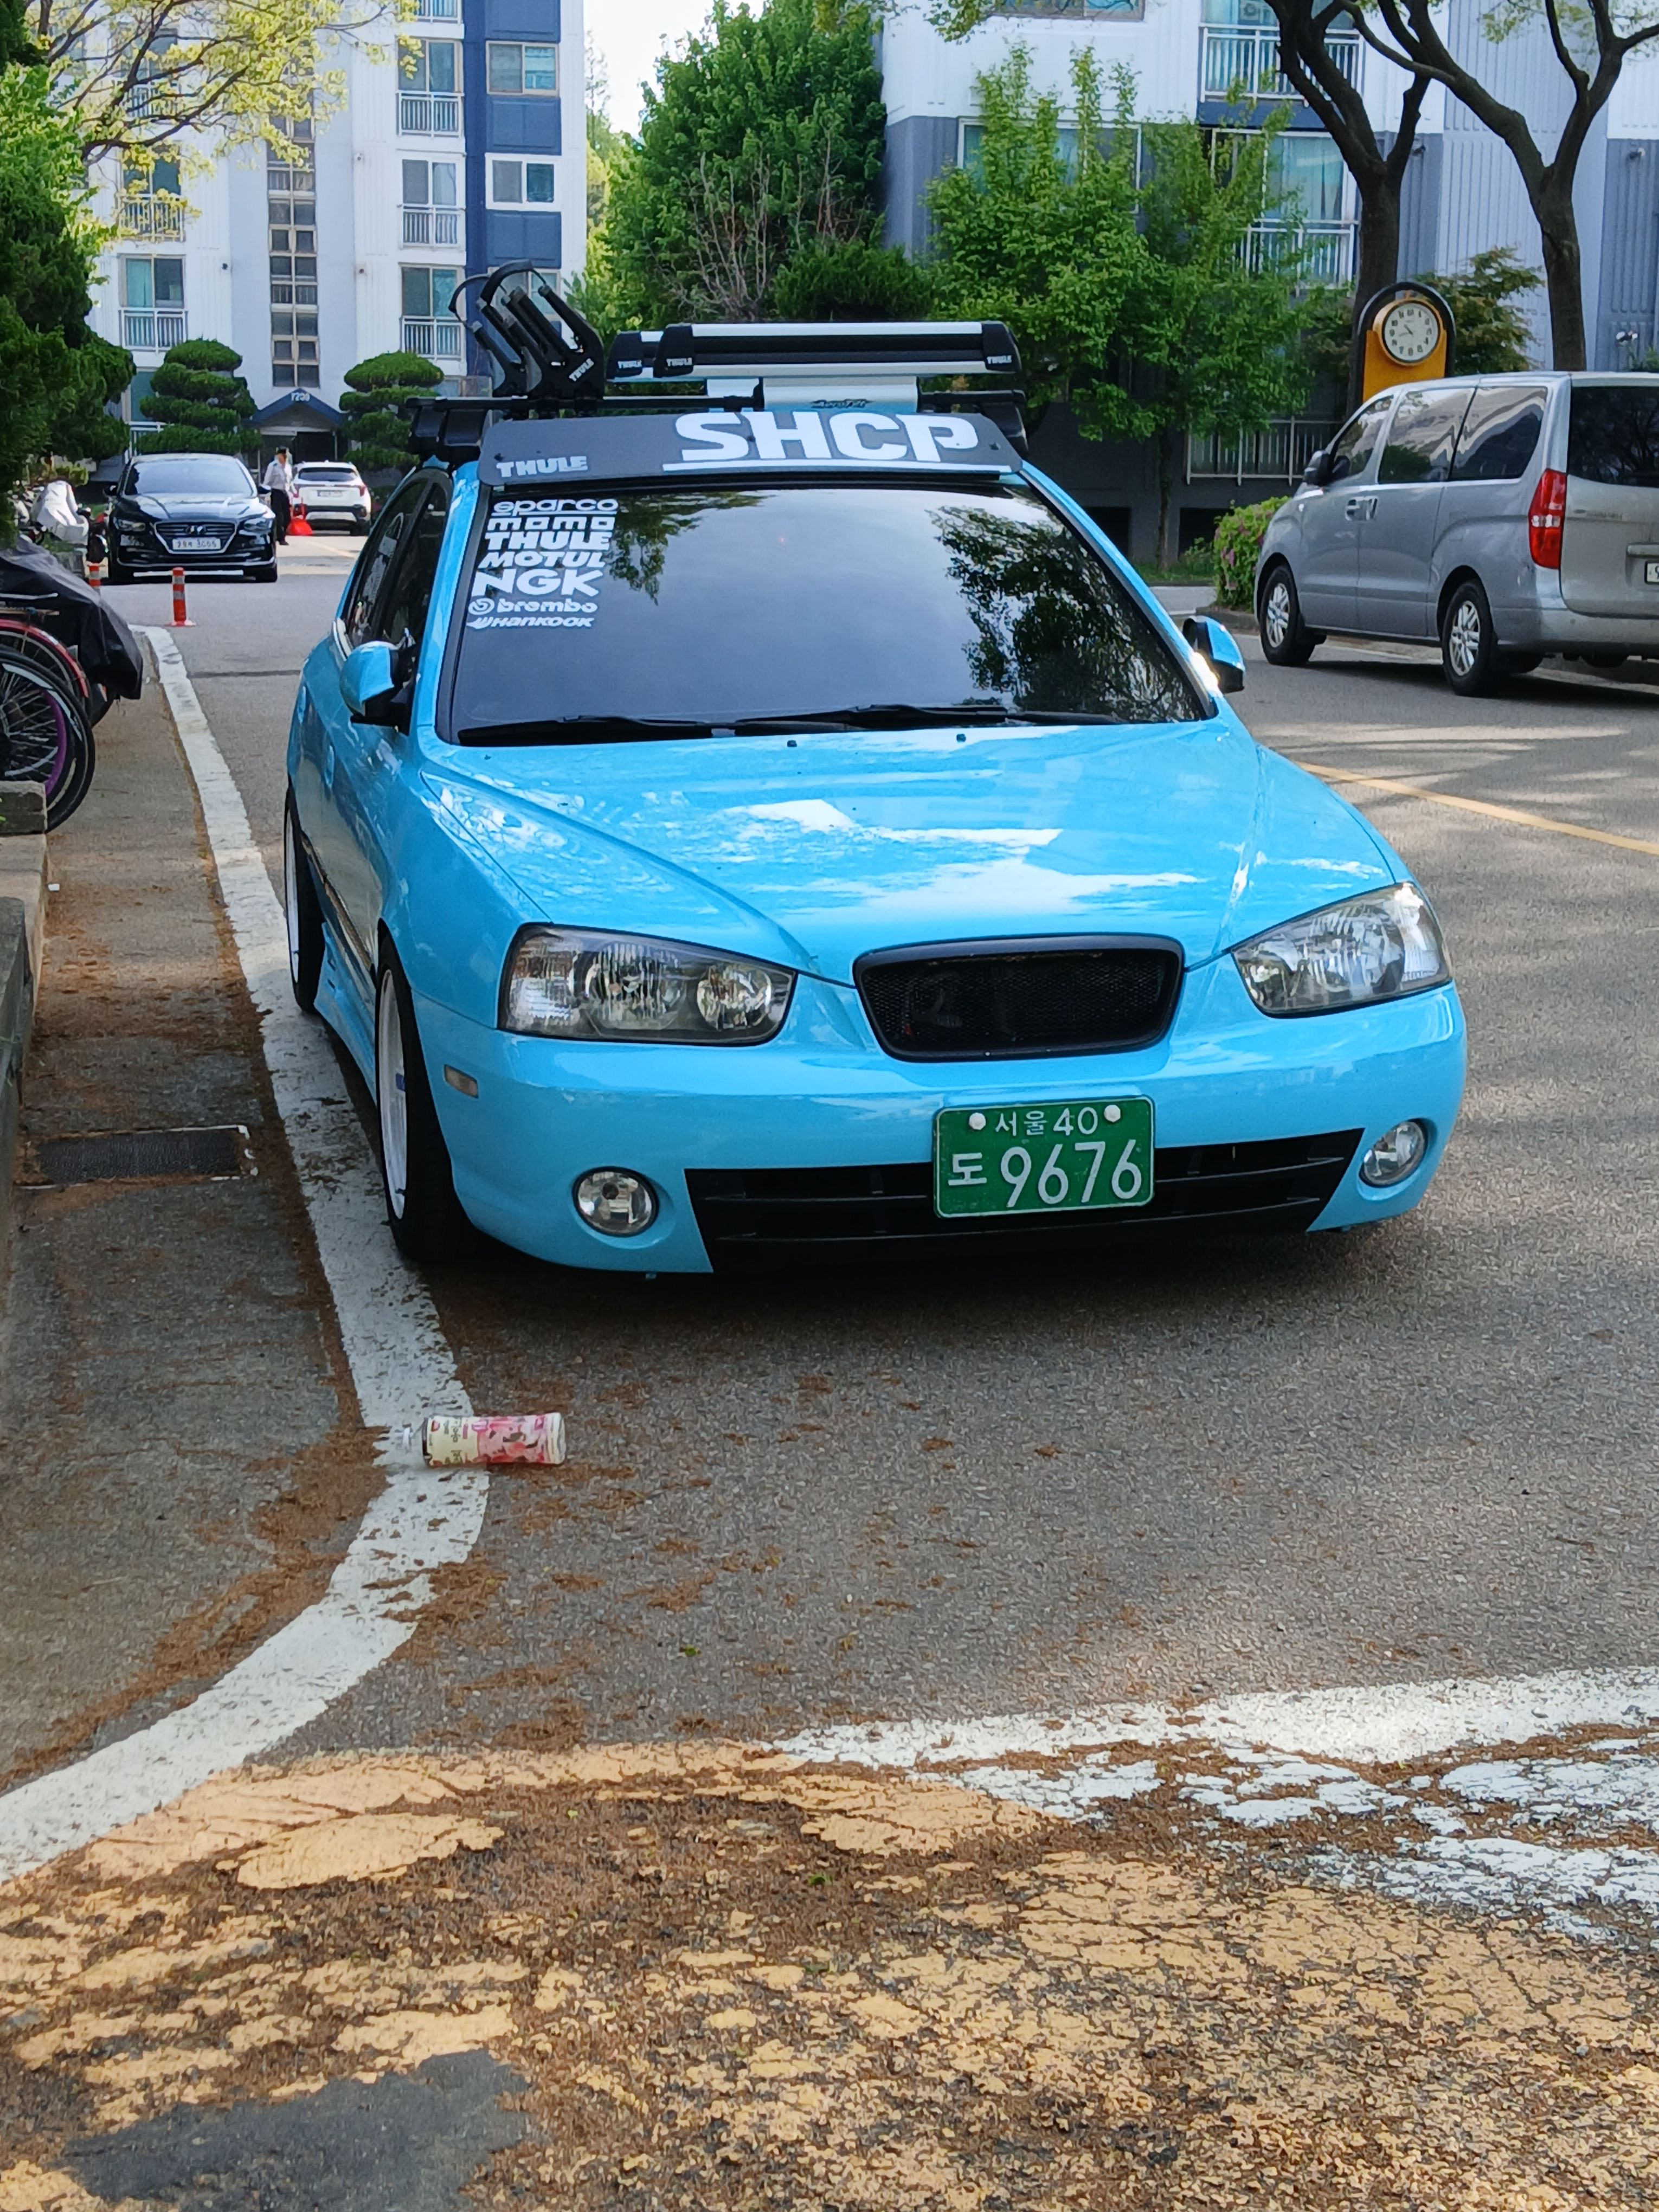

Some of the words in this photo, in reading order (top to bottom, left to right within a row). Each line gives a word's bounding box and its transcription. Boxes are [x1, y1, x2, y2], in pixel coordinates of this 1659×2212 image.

[675, 411, 978, 462] SHCP
[496, 456, 588, 477] THULE
[493, 498, 619, 516] sparco
[487, 517, 615, 531] momo
[485, 531, 613, 550] THULE
[478, 551, 606, 568] MOTUL
[471, 569, 603, 597] NGK
[497, 598, 598, 613] brembo
